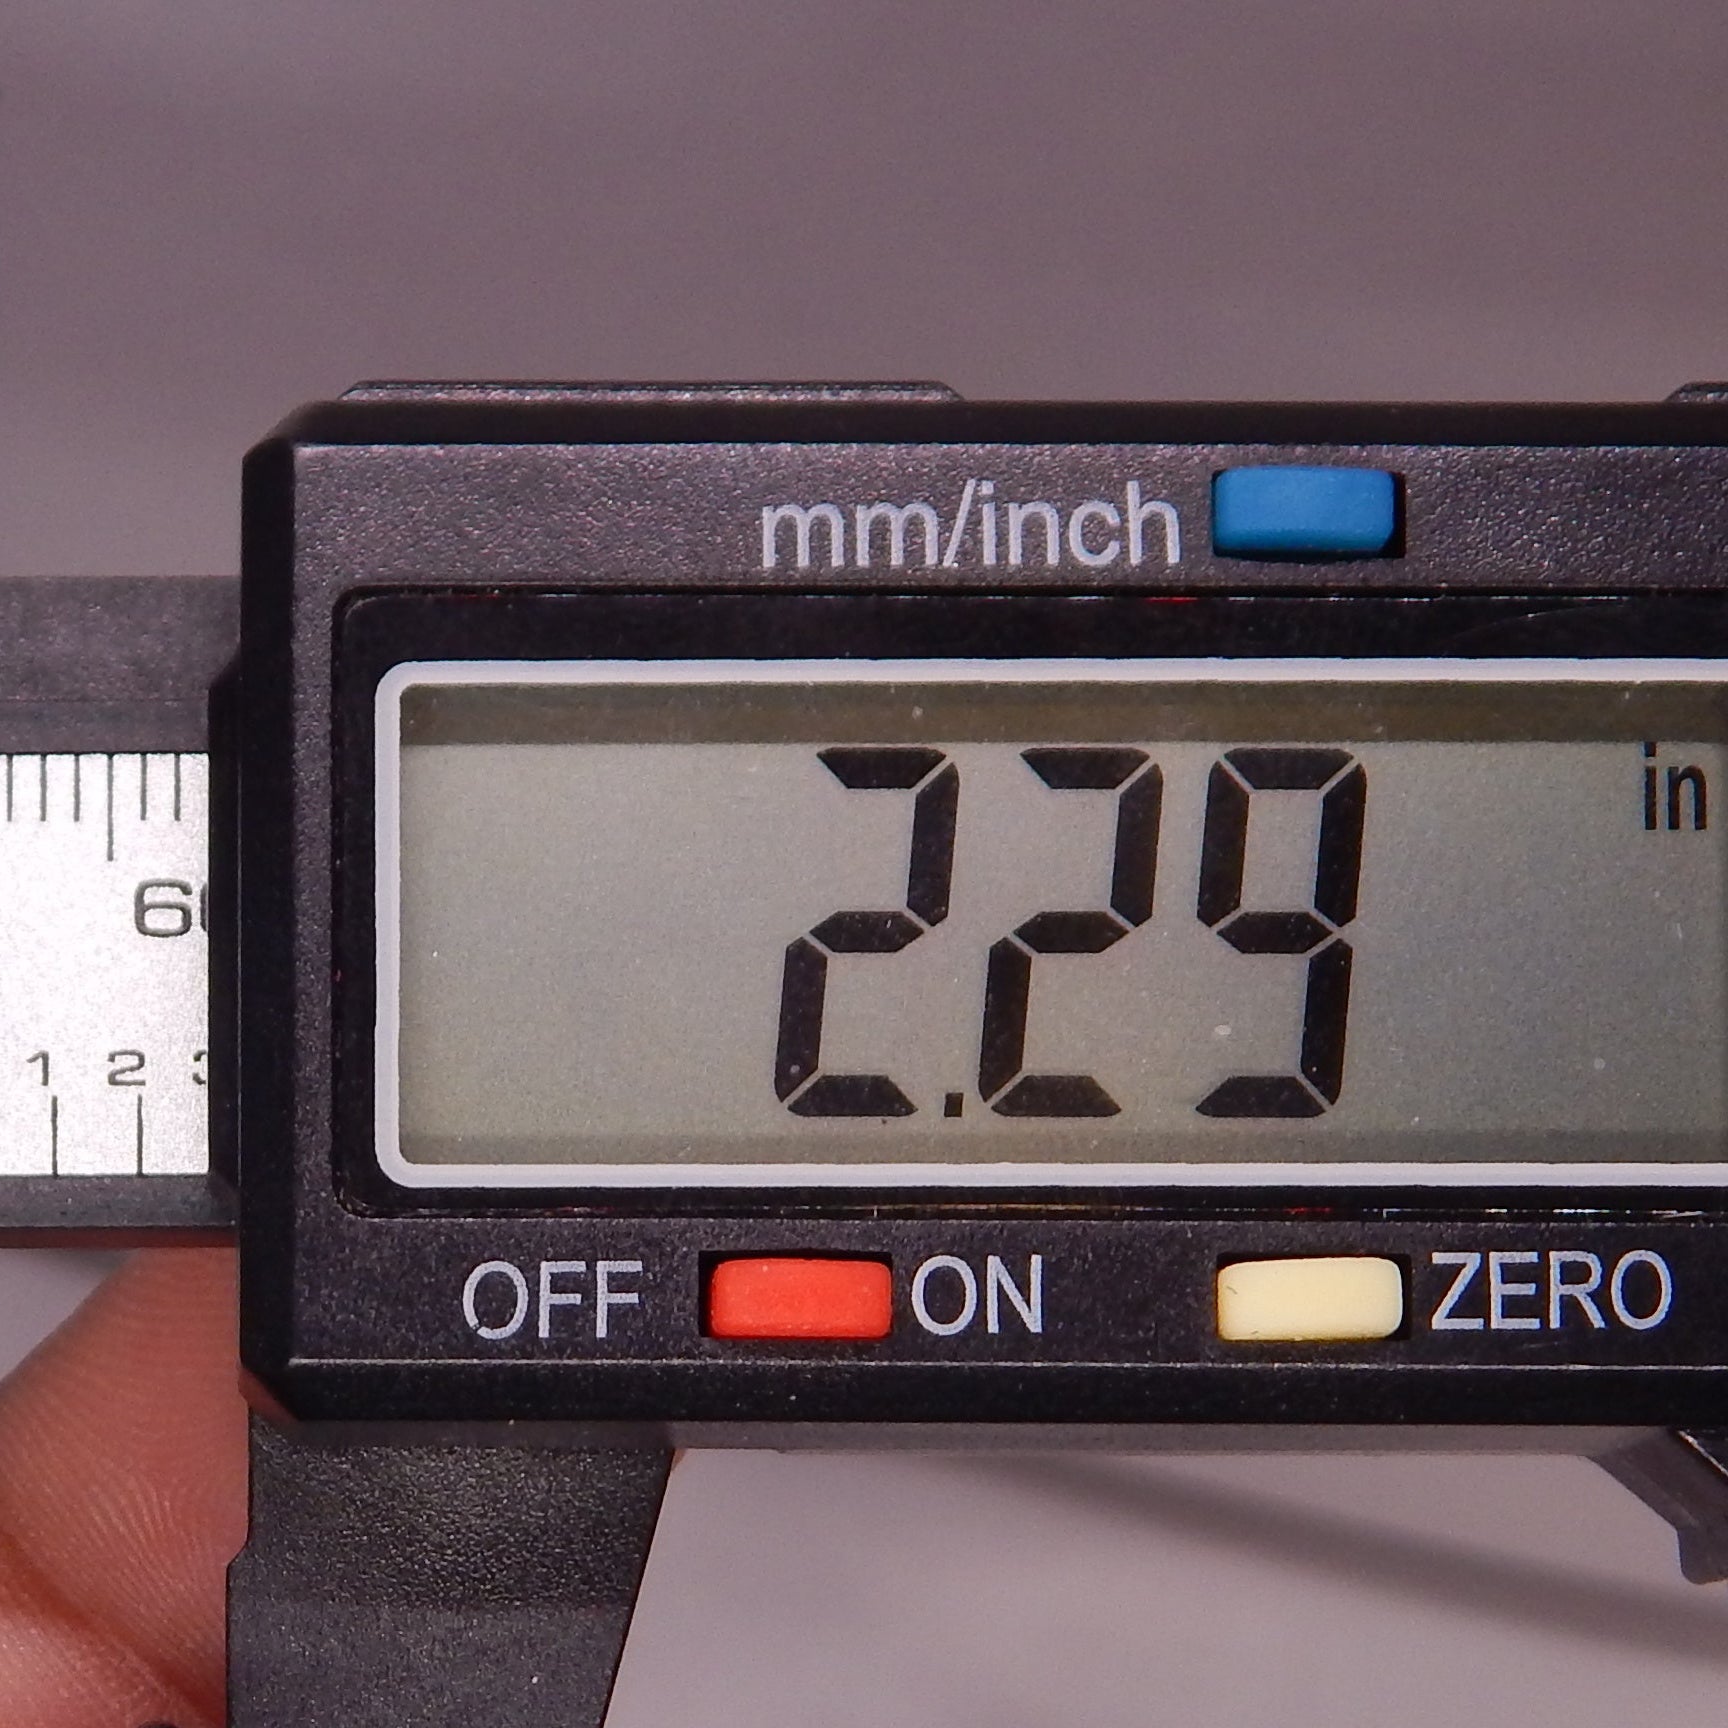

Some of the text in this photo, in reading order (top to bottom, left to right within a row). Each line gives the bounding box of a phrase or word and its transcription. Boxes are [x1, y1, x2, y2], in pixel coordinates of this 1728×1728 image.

[760, 479, 1183, 571] mm/inch
[1642, 740, 1708, 832] in
[133, 880, 209, 938] 6
[773, 746, 1369, 1119] 2.29
[26, 1052, 50, 1087] 1
[108, 1051, 147, 1087] 2
[461, 1249, 1674, 1341] OFF ON ZERO
